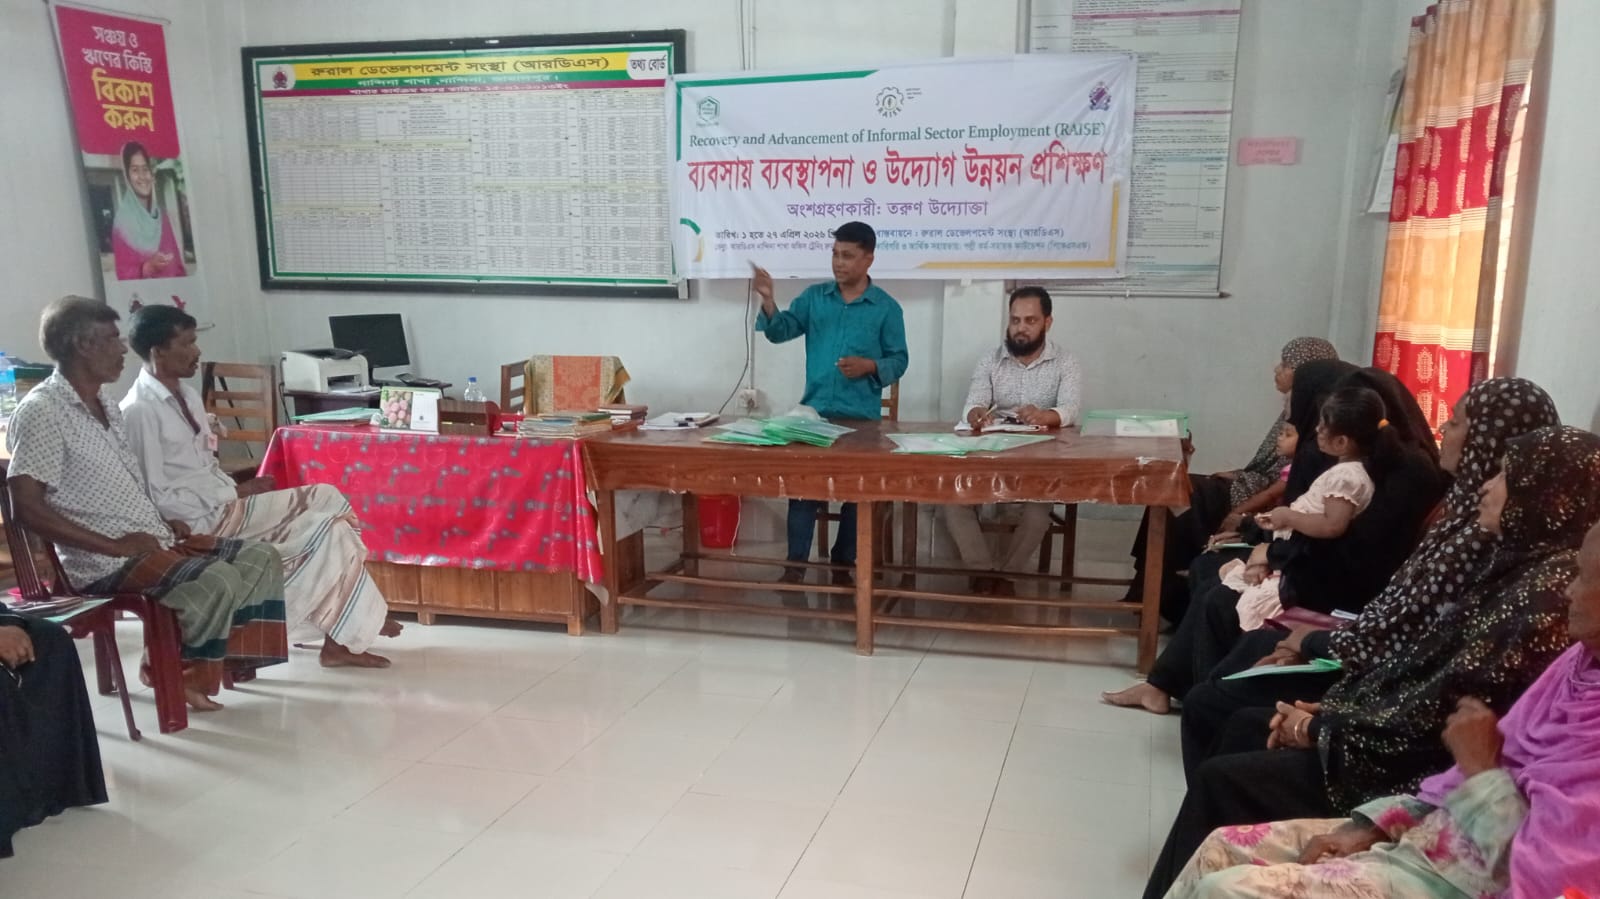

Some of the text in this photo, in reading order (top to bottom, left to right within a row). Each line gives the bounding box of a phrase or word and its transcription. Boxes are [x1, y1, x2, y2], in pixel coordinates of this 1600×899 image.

[91, 26, 138, 48] সঞ্চয় ও
[82, 48, 153, 74] ঋণের কিস্তি
[311, 57, 609, 77] রুরাল ডেভেলপমেন্ট সংস্থা (আরডিএস)
[91, 67, 155, 107] বিকাশ
[101, 103, 155, 132] করুন
[689, 122, 1106, 147] Recovery and Advancement of Informal Sector Employment (RAISE)
[687, 140, 1108, 196] ব্যবসায় ব্যবস্থাপনা ও উদ্যোগ উন্নয়ন প্রশিক্ষণ
[787, 197, 989, 217] অংশগ্রহণকারী: তরুণ উদ্যোক্তা
